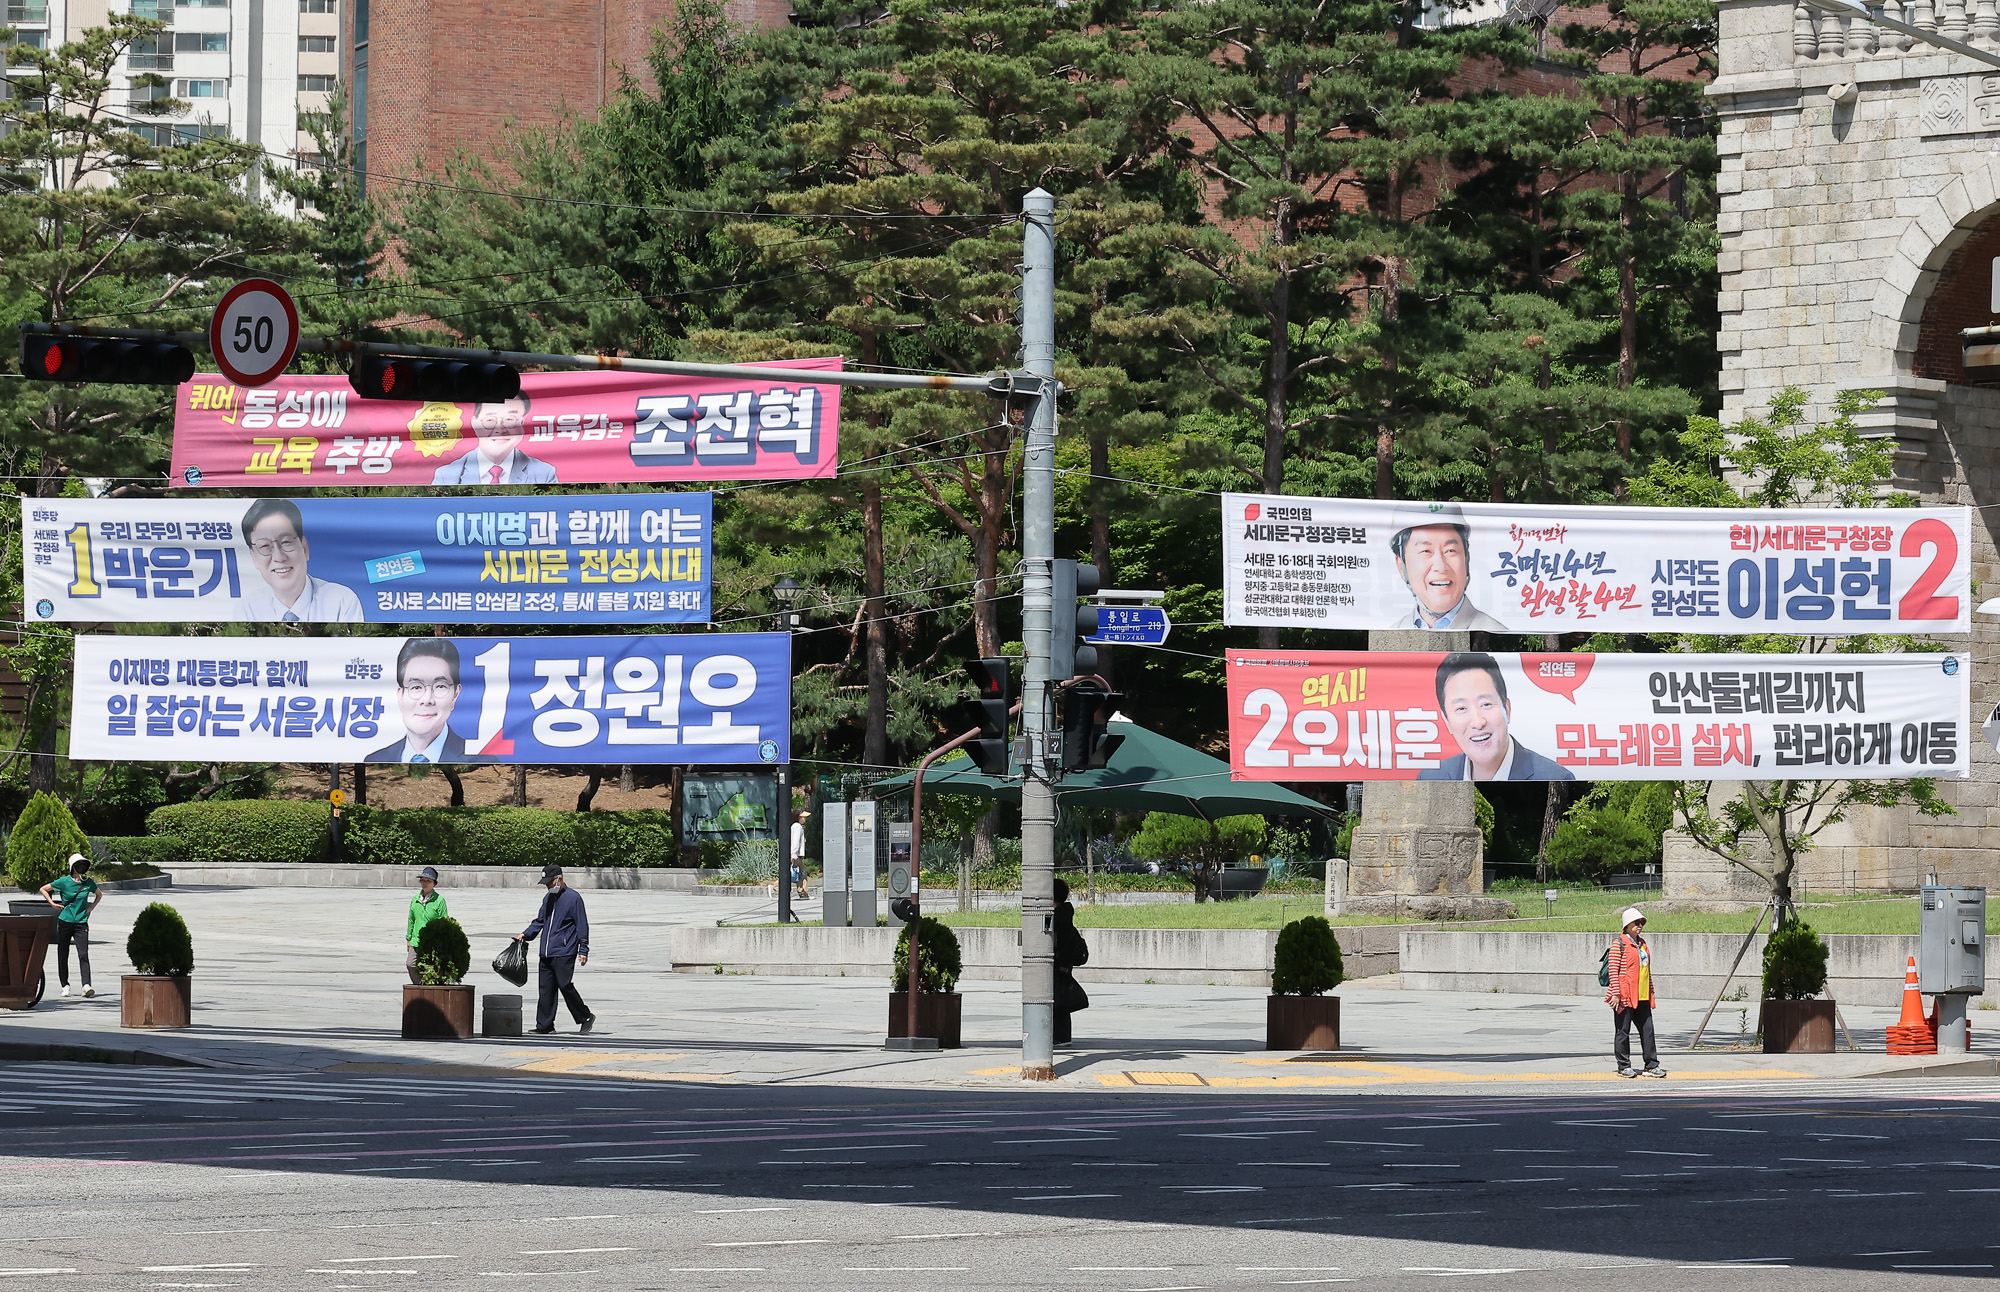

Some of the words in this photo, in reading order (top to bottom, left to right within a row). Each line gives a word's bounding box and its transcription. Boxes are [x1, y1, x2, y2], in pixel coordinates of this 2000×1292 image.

[233, 316, 274, 354] 50
[189, 384, 234, 411] 퀴어
[240, 389, 348, 428] 동성애
[528, 413, 624, 442] 교육감은
[629, 387, 819, 462] 조전혁
[244, 437, 319, 474] 교육
[325, 436, 402, 474] 추방
[32, 510, 59, 522] 민주당
[435, 511, 558, 547] 이재명과
[568, 509, 630, 545] 함께
[640, 508, 702, 544] 여는
[1266, 507, 1312, 521] 국민의힘
[33, 529, 59, 541] 서대문
[100, 522, 131, 540] 우리
[135, 522, 183, 540] 모두의
[185, 522, 233, 540] 구청장
[1244, 524, 1367, 544] 서대문구청장후보
[1509, 523, 1542, 555] 획기적
[1543, 523, 1568, 545] 변화
[1729, 524, 1893, 554] 현)서대문구청장
[33, 542, 60, 553] 구청장
[34, 554, 52, 565] 후보
[64, 522, 102, 598] 1
[1244, 553, 1276, 567] 서대문
[1277, 554, 1314, 568] 16·18대
[1316, 555, 1370, 570] 국회의원(전)
[103, 547, 241, 598] 박운기
[374, 556, 417, 580] 천연동
[480, 548, 569, 585] 서대문
[578, 547, 702, 583] 전성시대
[1244, 568, 1283, 579] 연세대학교
[1490, 549, 1563, 588] 증명된
[1563, 548, 1616, 580] 4년
[1651, 558, 1719, 586] 시작도
[1898, 518, 1959, 621] 2
[376, 591, 423, 612] 경사로
[426, 591, 472, 612] 스마트
[475, 591, 522, 612] 안심길
[524, 591, 559, 613] 조성,
[562, 591, 595, 612] 틈새
[597, 591, 630, 612] 돌봄
[632, 590, 665, 611] 지원
[667, 590, 701, 611] 확대
[1244, 594, 1290, 605] 성균관대학교
[1291, 594, 1314, 606] 대학원
[1315, 595, 1338, 606] 언론학
[1339, 595, 1355, 607] 박사
[1301, 582, 1351, 594] 총동문회장(전)
[1520, 581, 1597, 619] 완성할
[1594, 579, 1643, 613] 4년
[1727, 556, 1892, 621] 이성헌
[1107, 610, 1141, 623] 통일로
[1244, 606, 1290, 618] 한국애견협회
[1291, 607, 1327, 619] 부회장(현)
[1651, 590, 1719, 617] 완성도
[1147, 621, 1162, 631] 219
[109, 658, 169, 686] 이재명
[176, 659, 259, 687] 대통령과
[265, 660, 309, 688] 함께
[345, 664, 383, 680] 민주당
[1538, 661, 1576, 678] 천연동
[464, 641, 515, 756] 1
[529, 654, 761, 748] 정원오
[1301, 667, 1367, 708] 역시!
[1649, 670, 1866, 714] 안산둘레길까지
[107, 694, 137, 736] 일
[145, 695, 244, 737] 잘하는
[250, 696, 385, 738] 서울시장
[1243, 688, 1289, 768] 2
[1292, 708, 1442, 770] 오세훈
[1555, 723, 1682, 767] 모노레일
[1691, 723, 1761, 769] 설치,
[1774, 722, 1891, 767] 편리하게
[1901, 721, 1958, 766] 이동
